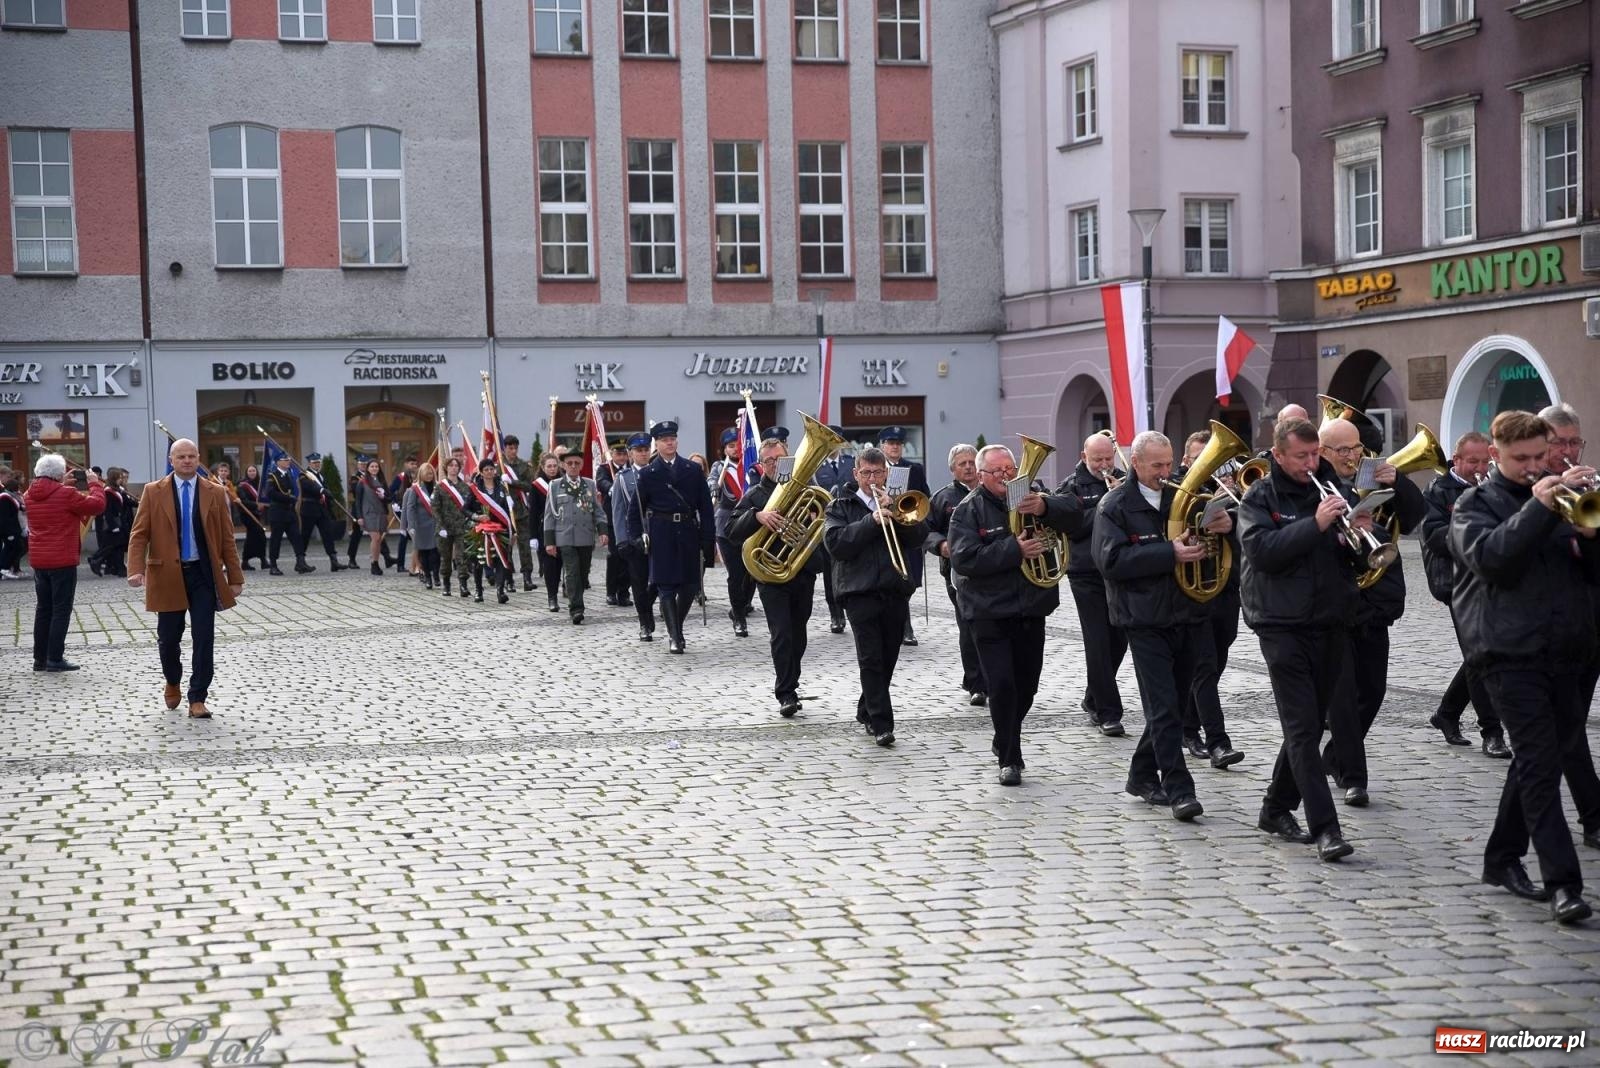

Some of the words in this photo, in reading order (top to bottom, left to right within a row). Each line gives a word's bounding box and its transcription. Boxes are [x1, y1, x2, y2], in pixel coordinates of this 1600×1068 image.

[1431, 246, 1565, 299] KANTOR
[1317, 271, 1395, 299] TABAC
[377, 354, 447, 364] RESTAURACJA
[684, 352, 809, 377] JUBILER
[212, 362, 296, 381] BOLKO
[353, 366, 438, 380] RACIBORSKA
[574, 409, 624, 423] ZTO
[854, 403, 908, 417] SREBRO
